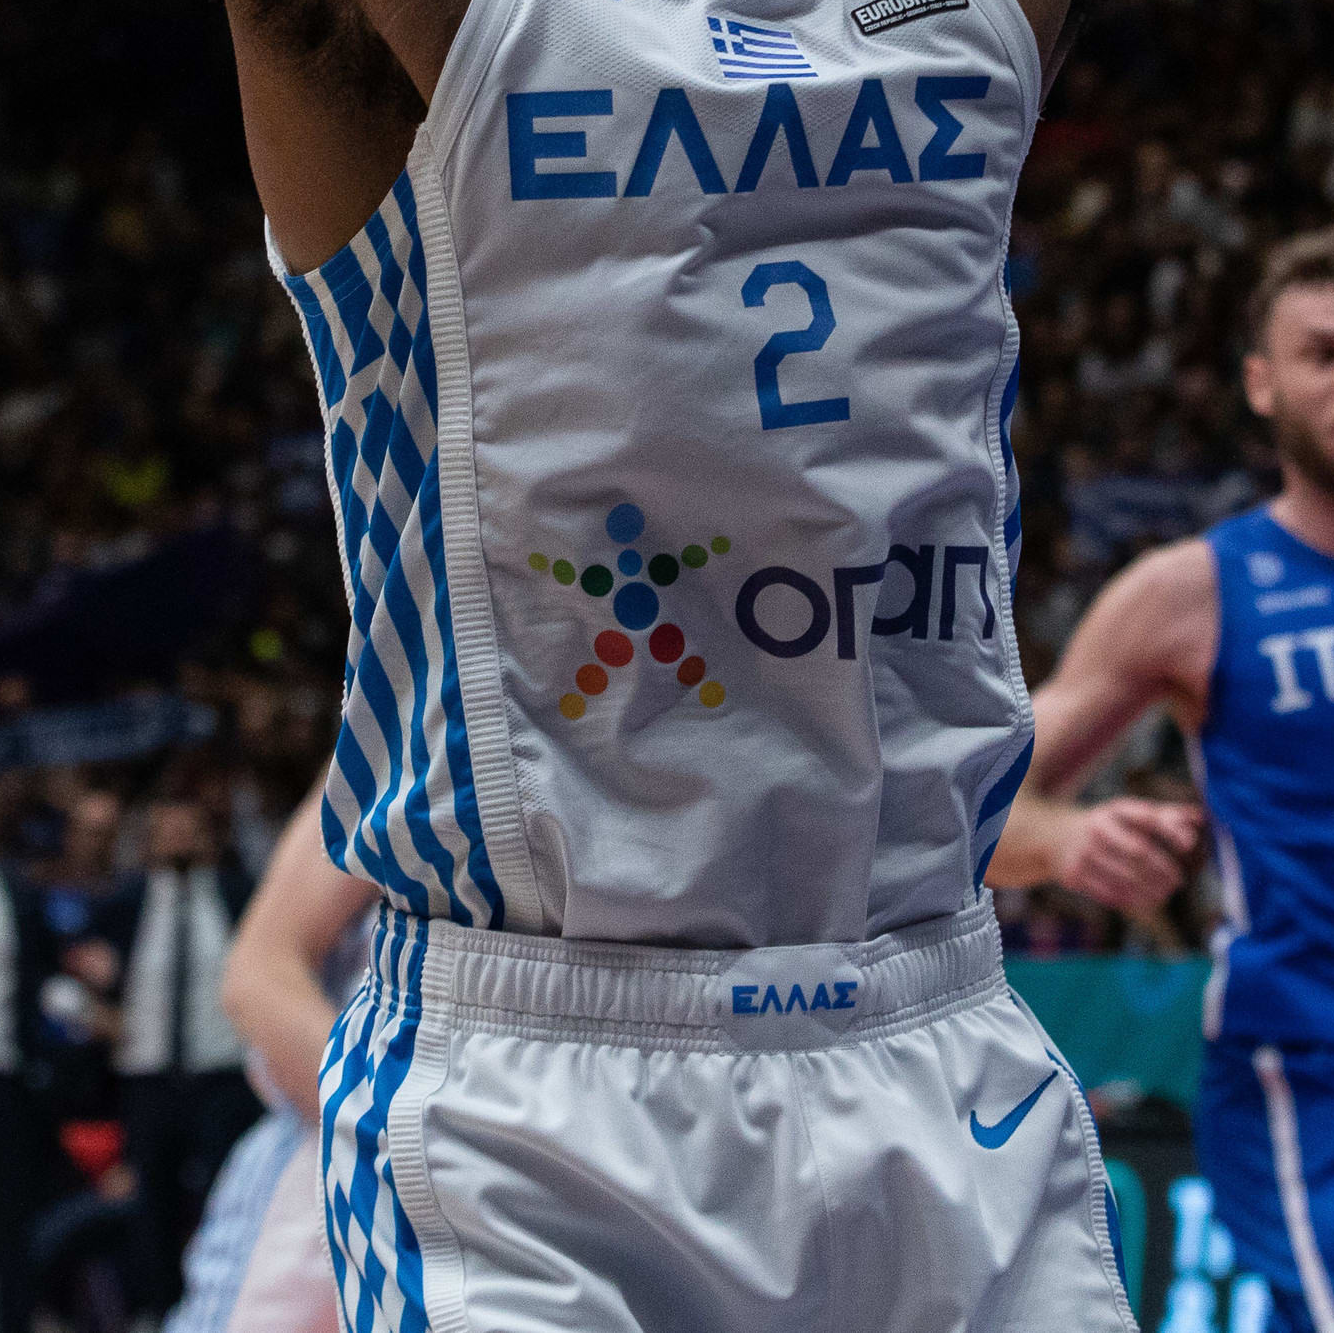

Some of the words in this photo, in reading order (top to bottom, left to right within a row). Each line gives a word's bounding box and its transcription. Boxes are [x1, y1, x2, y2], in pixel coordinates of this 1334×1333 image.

[506, 75, 992, 202] ΕΛΛΑΣ
[741, 260, 851, 431] 2
[732, 981, 858, 1015] ΕΛΛΑΣ
